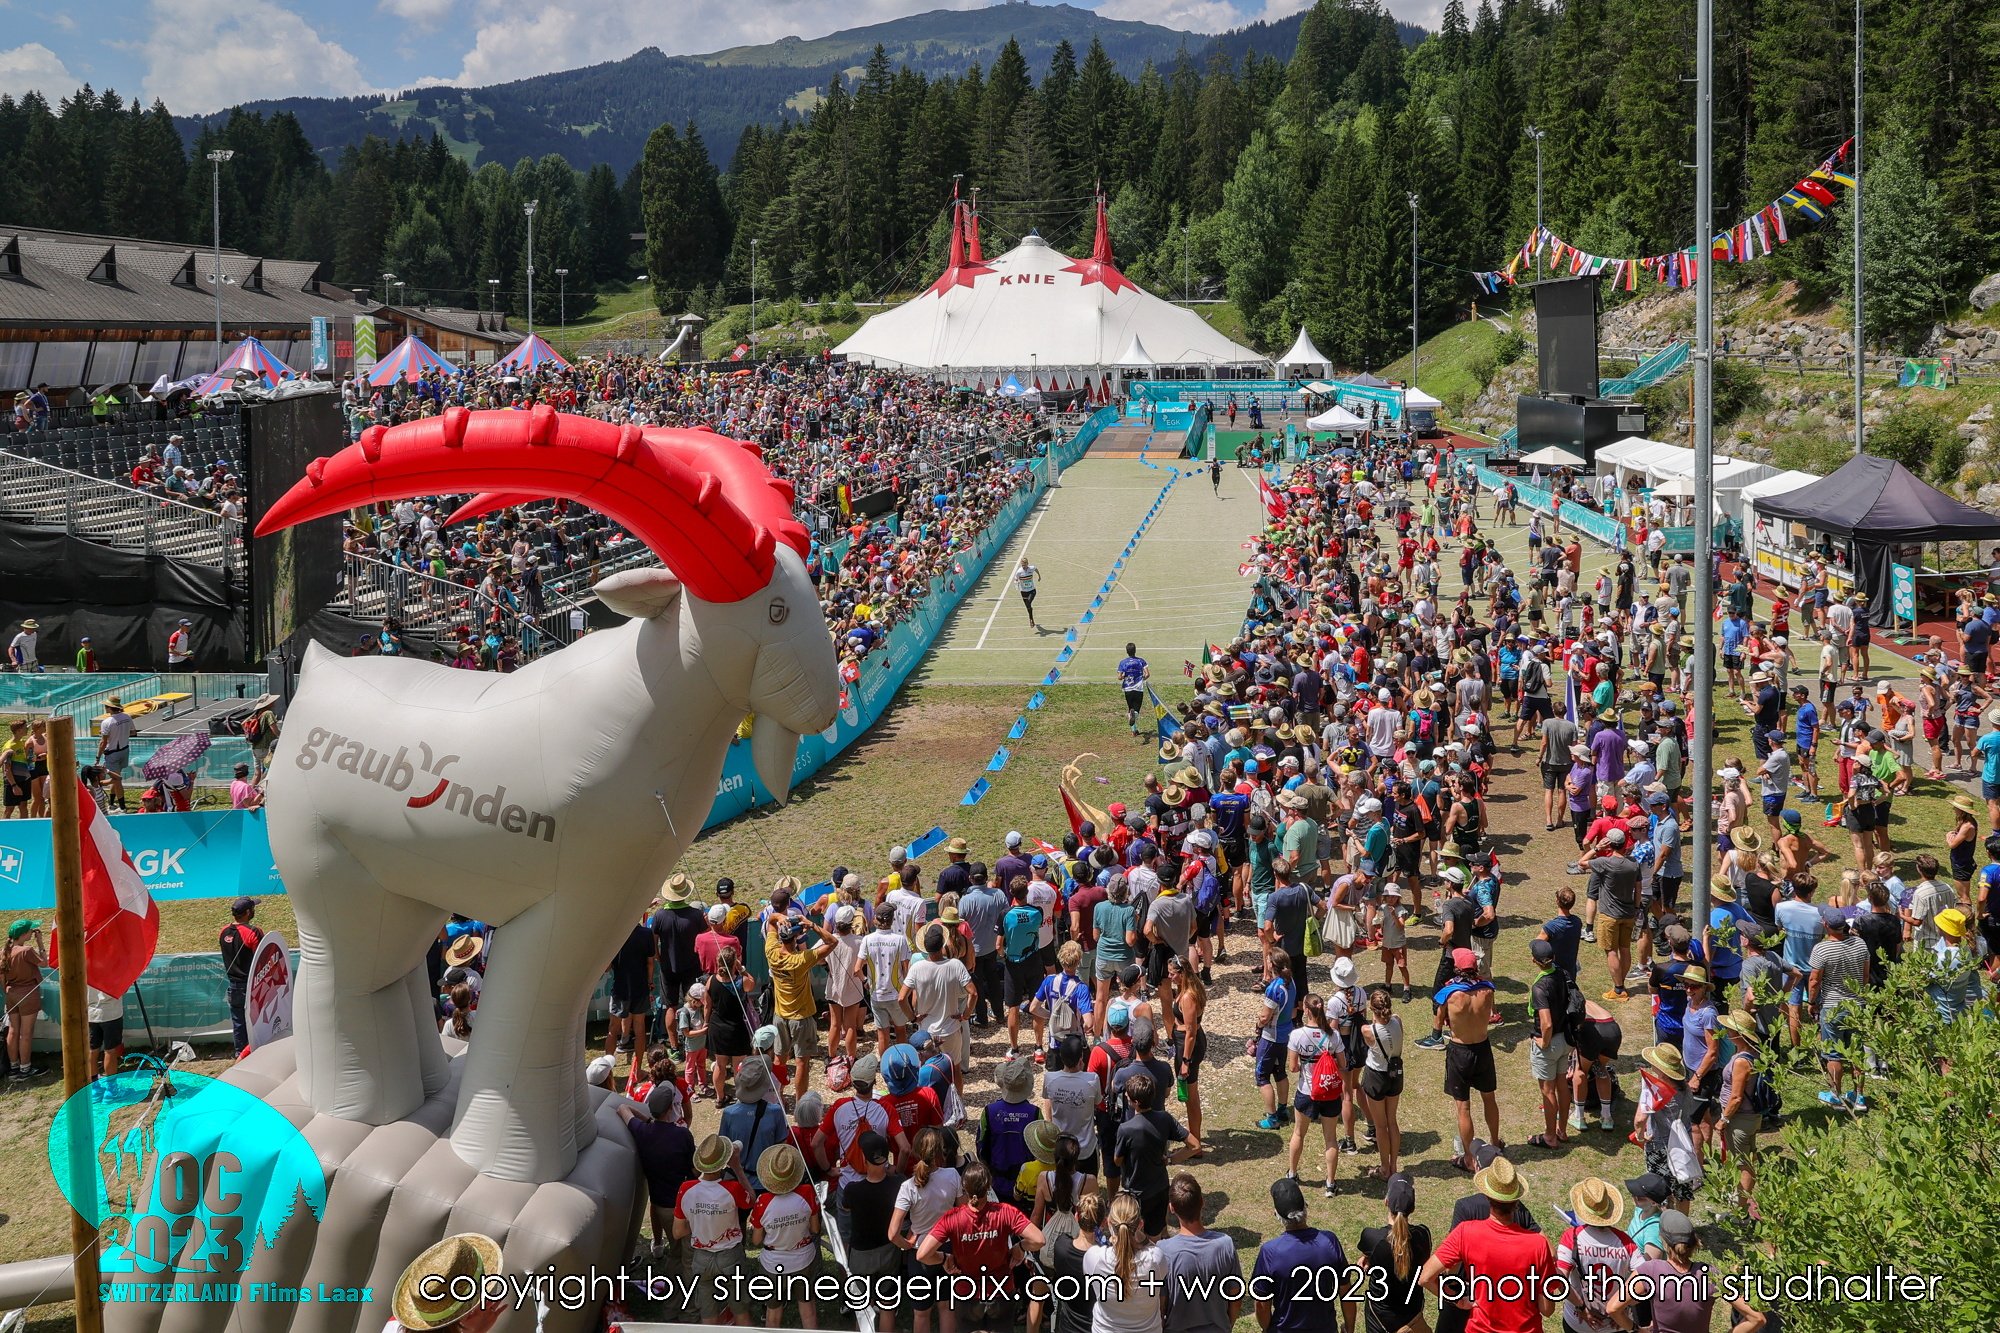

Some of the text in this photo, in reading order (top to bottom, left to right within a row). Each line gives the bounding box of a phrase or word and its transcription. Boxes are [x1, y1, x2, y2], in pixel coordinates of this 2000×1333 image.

[999, 273, 1056, 286] KNIE
[689, 1208, 728, 1216] SUPPORTER
[695, 1202, 720, 1210] SUISSE
[765, 1216, 807, 1230] SUPPORTER
[773, 1213, 800, 1224] SUISSE
[961, 1229, 998, 1242] AUSTRIA
